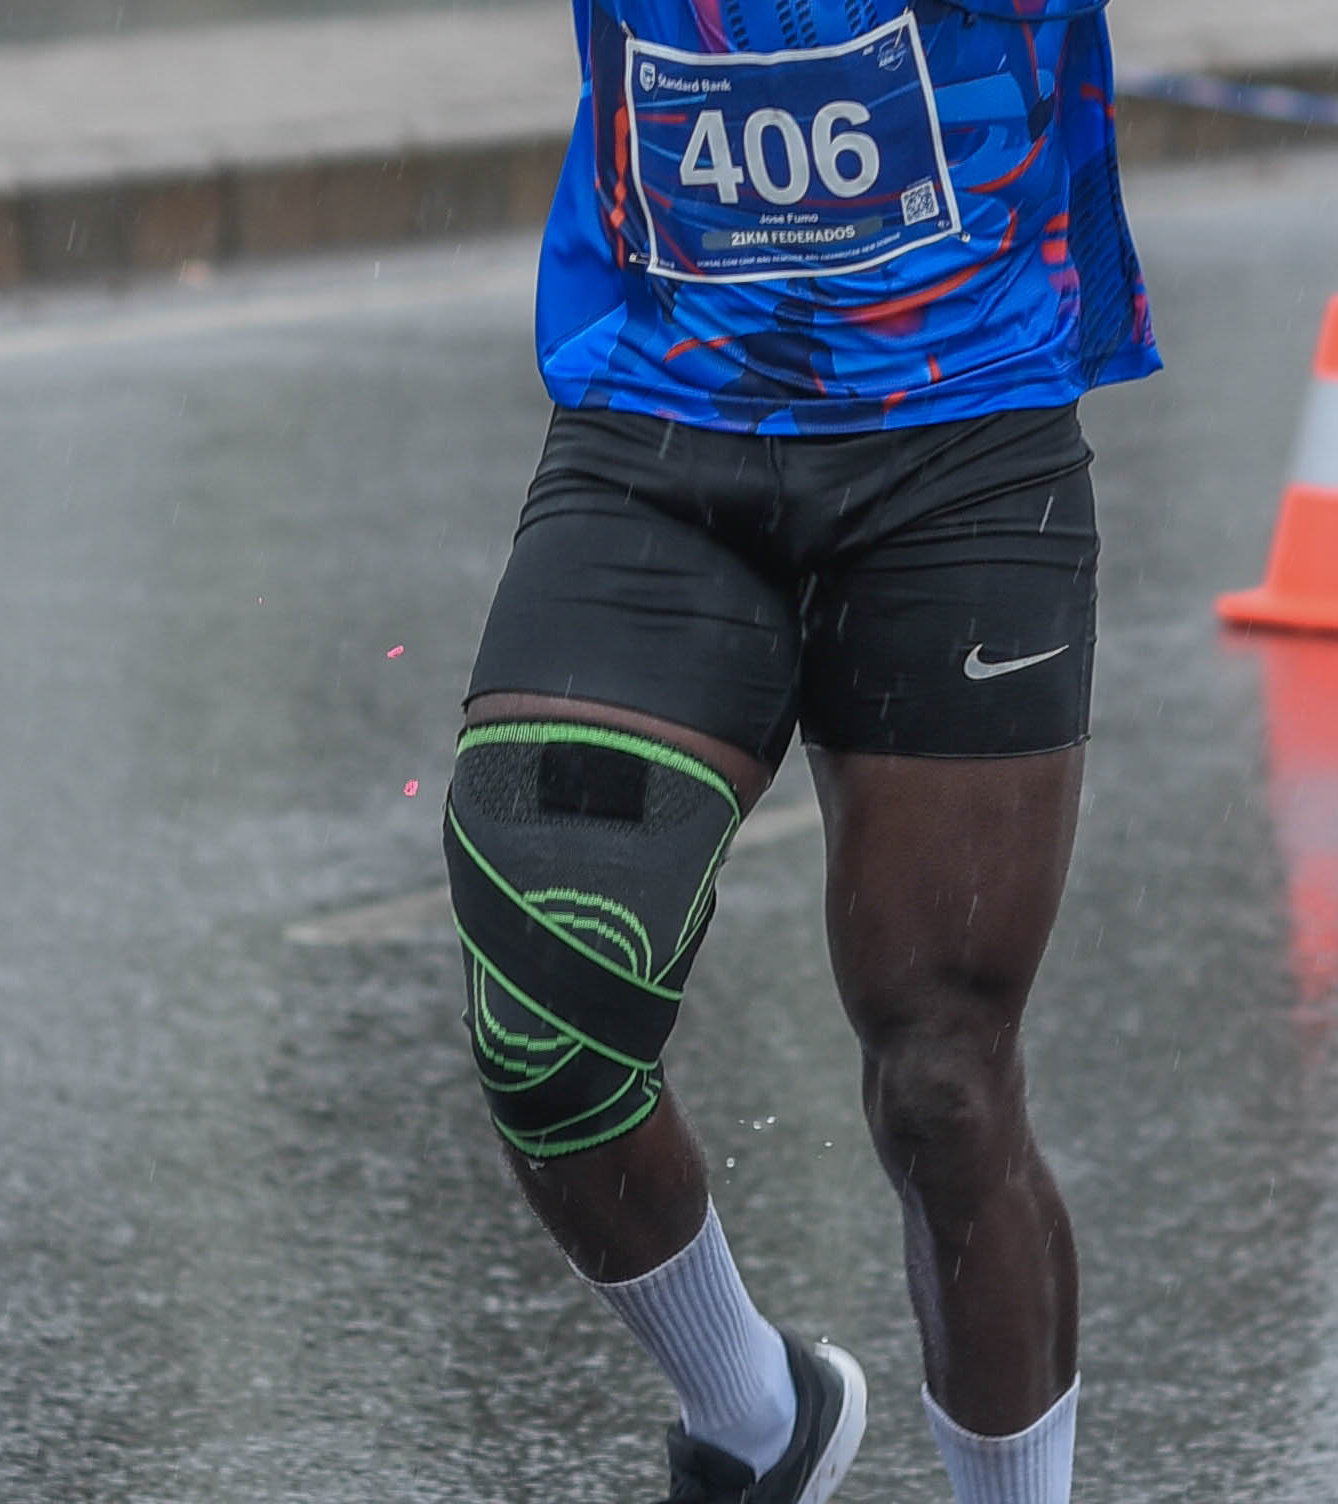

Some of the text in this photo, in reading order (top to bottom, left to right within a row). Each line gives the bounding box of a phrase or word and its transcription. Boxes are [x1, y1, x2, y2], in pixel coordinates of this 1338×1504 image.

[657, 73, 732, 93] Standard Bank
[680, 100, 880, 205] 406
[787, 212, 819, 224] Fumo
[731, 230, 769, 246] 21KM
[771, 224, 856, 244] FEDERADOS
